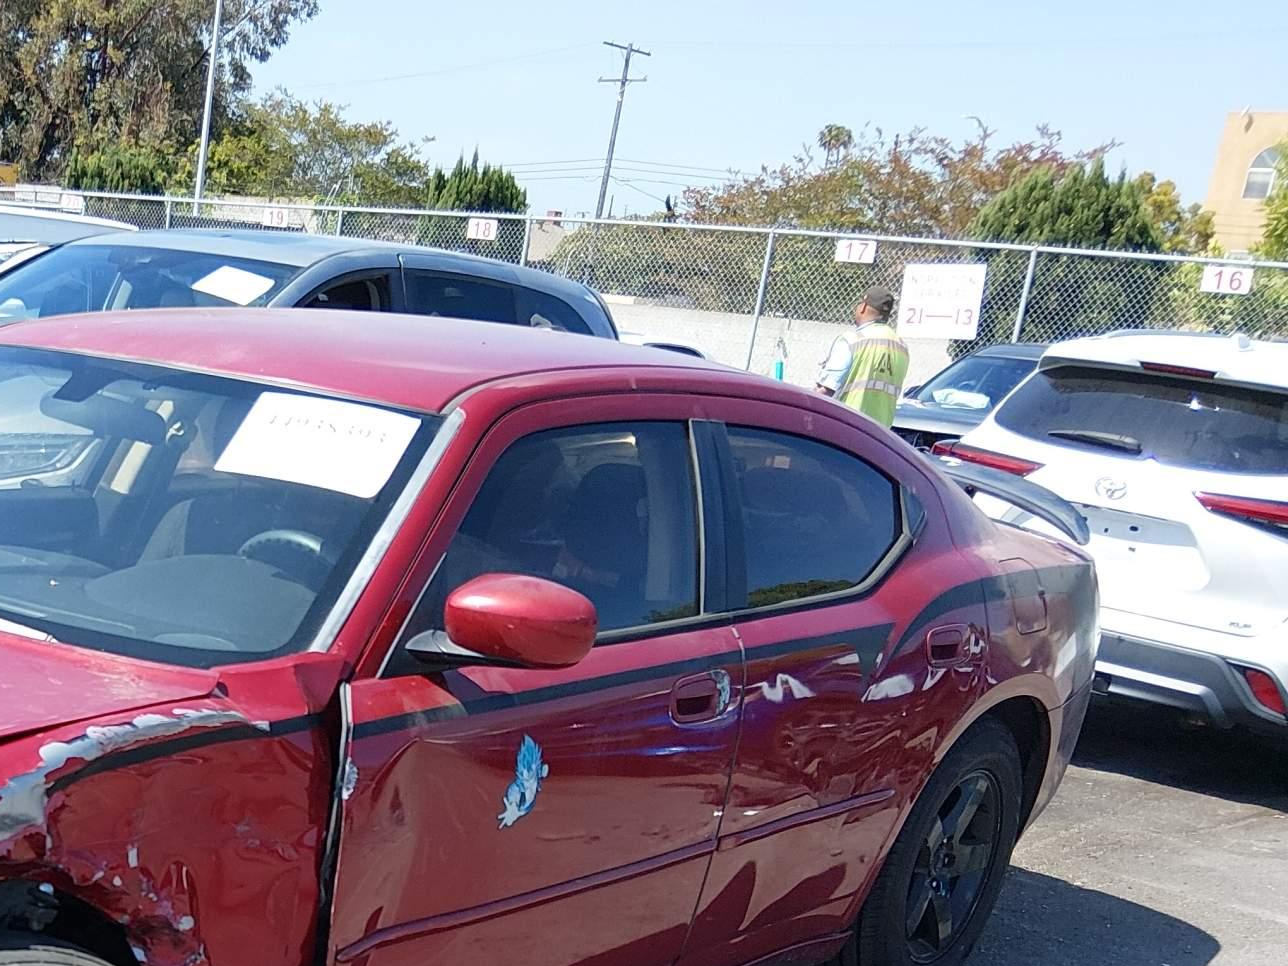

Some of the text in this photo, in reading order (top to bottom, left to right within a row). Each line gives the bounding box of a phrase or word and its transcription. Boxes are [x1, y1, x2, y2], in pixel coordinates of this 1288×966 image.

[269, 210, 284, 225] 19
[474, 221, 492, 238] 18
[845, 242, 870, 261] 17
[1214, 269, 1244, 292] 16
